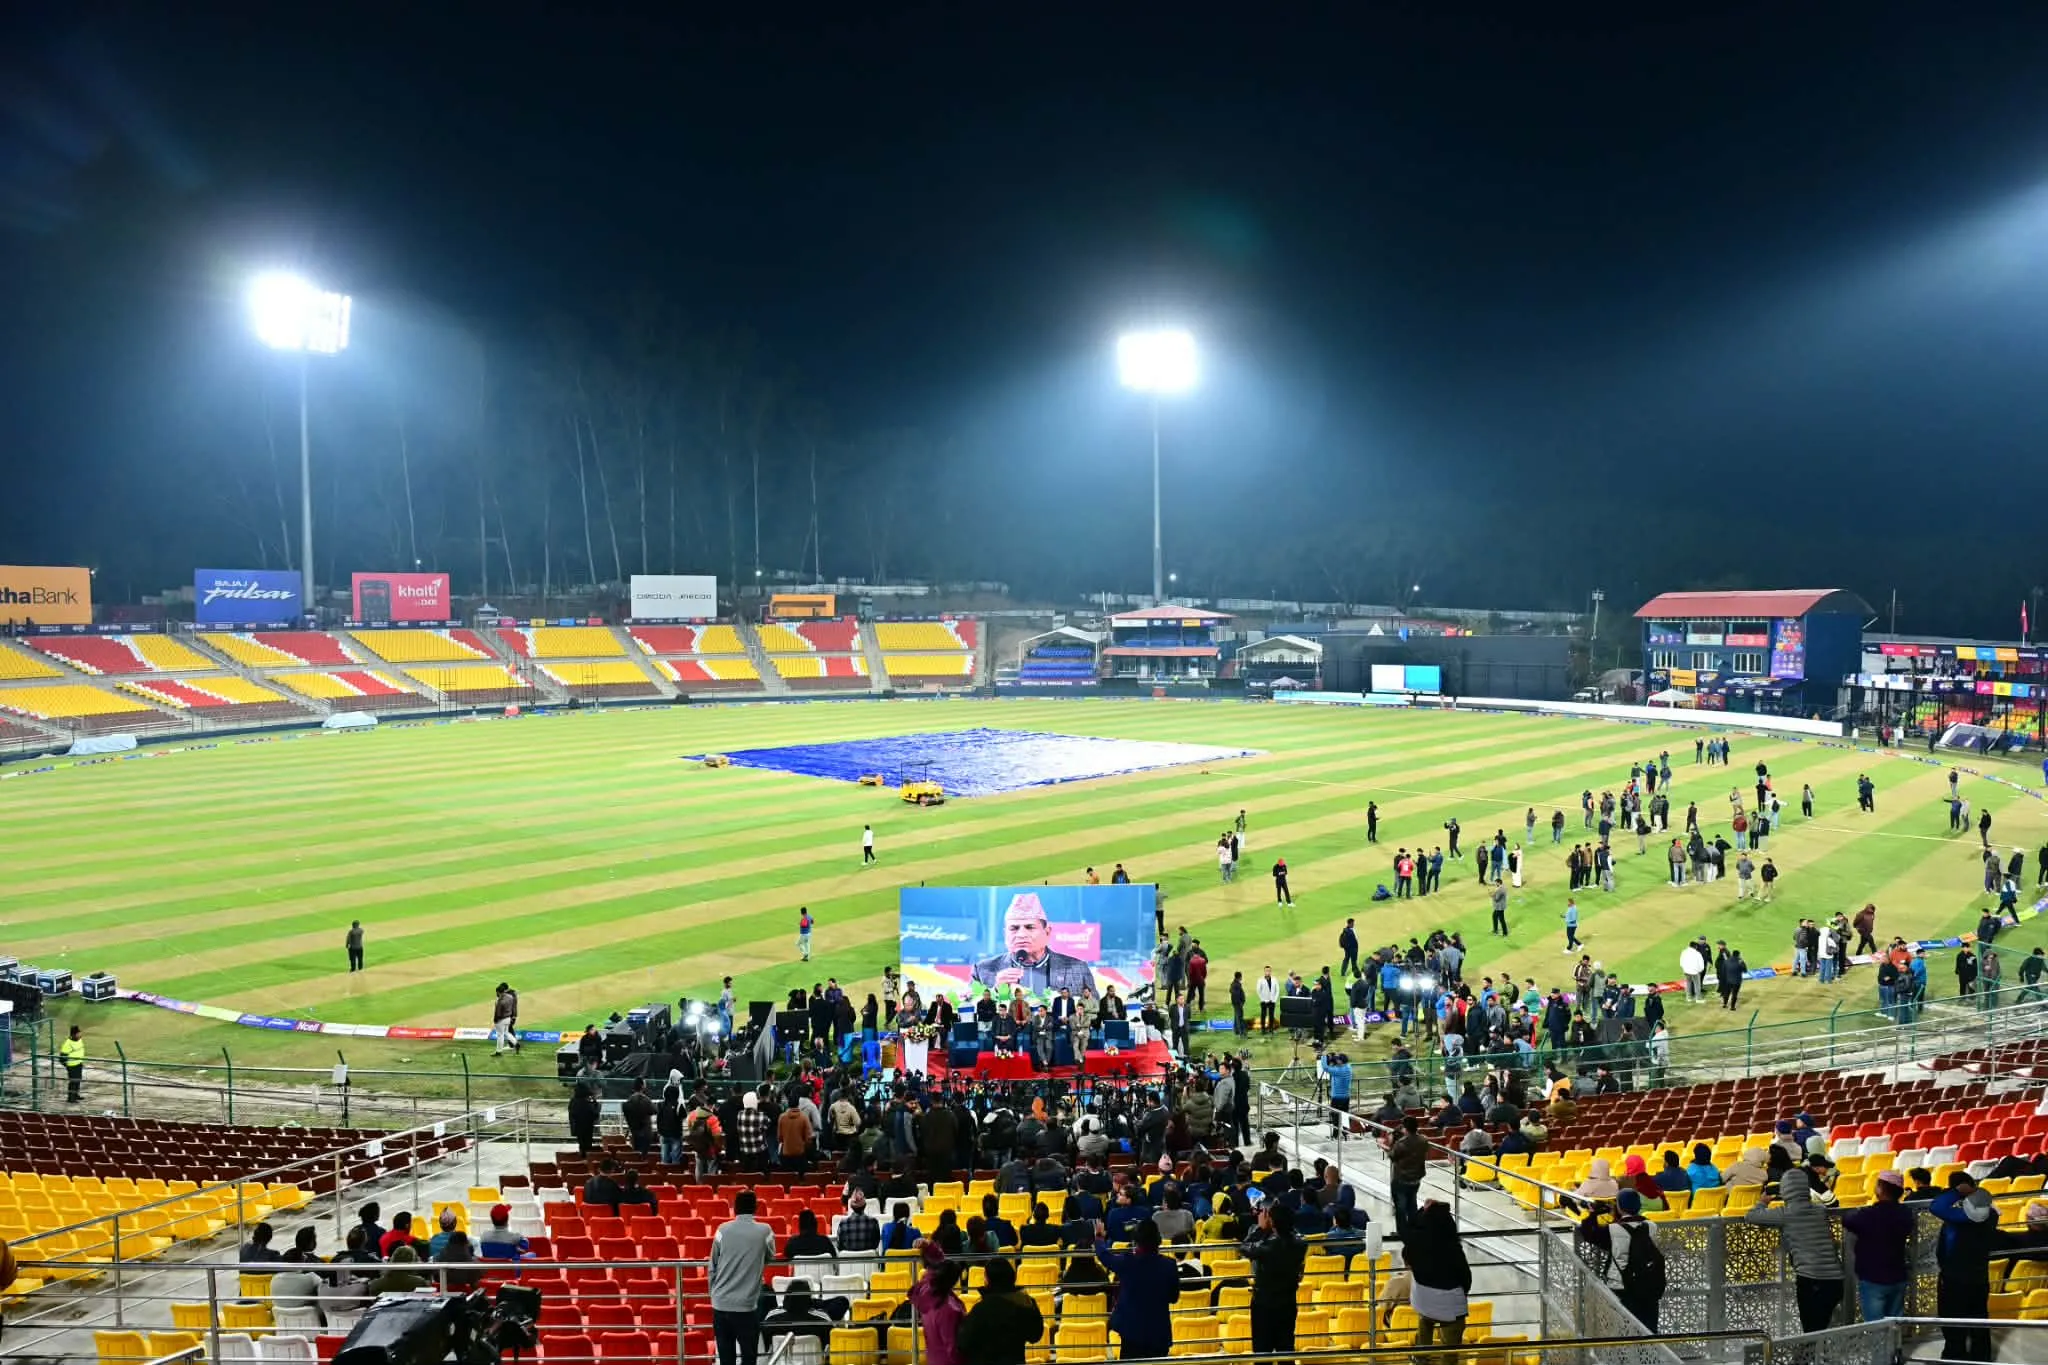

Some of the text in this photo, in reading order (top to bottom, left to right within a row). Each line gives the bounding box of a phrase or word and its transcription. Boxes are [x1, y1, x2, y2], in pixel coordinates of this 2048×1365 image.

[203, 581, 296, 605] pulsar
[398, 584, 438, 597] khalti
[296, 1021, 320, 1032] Ncell
